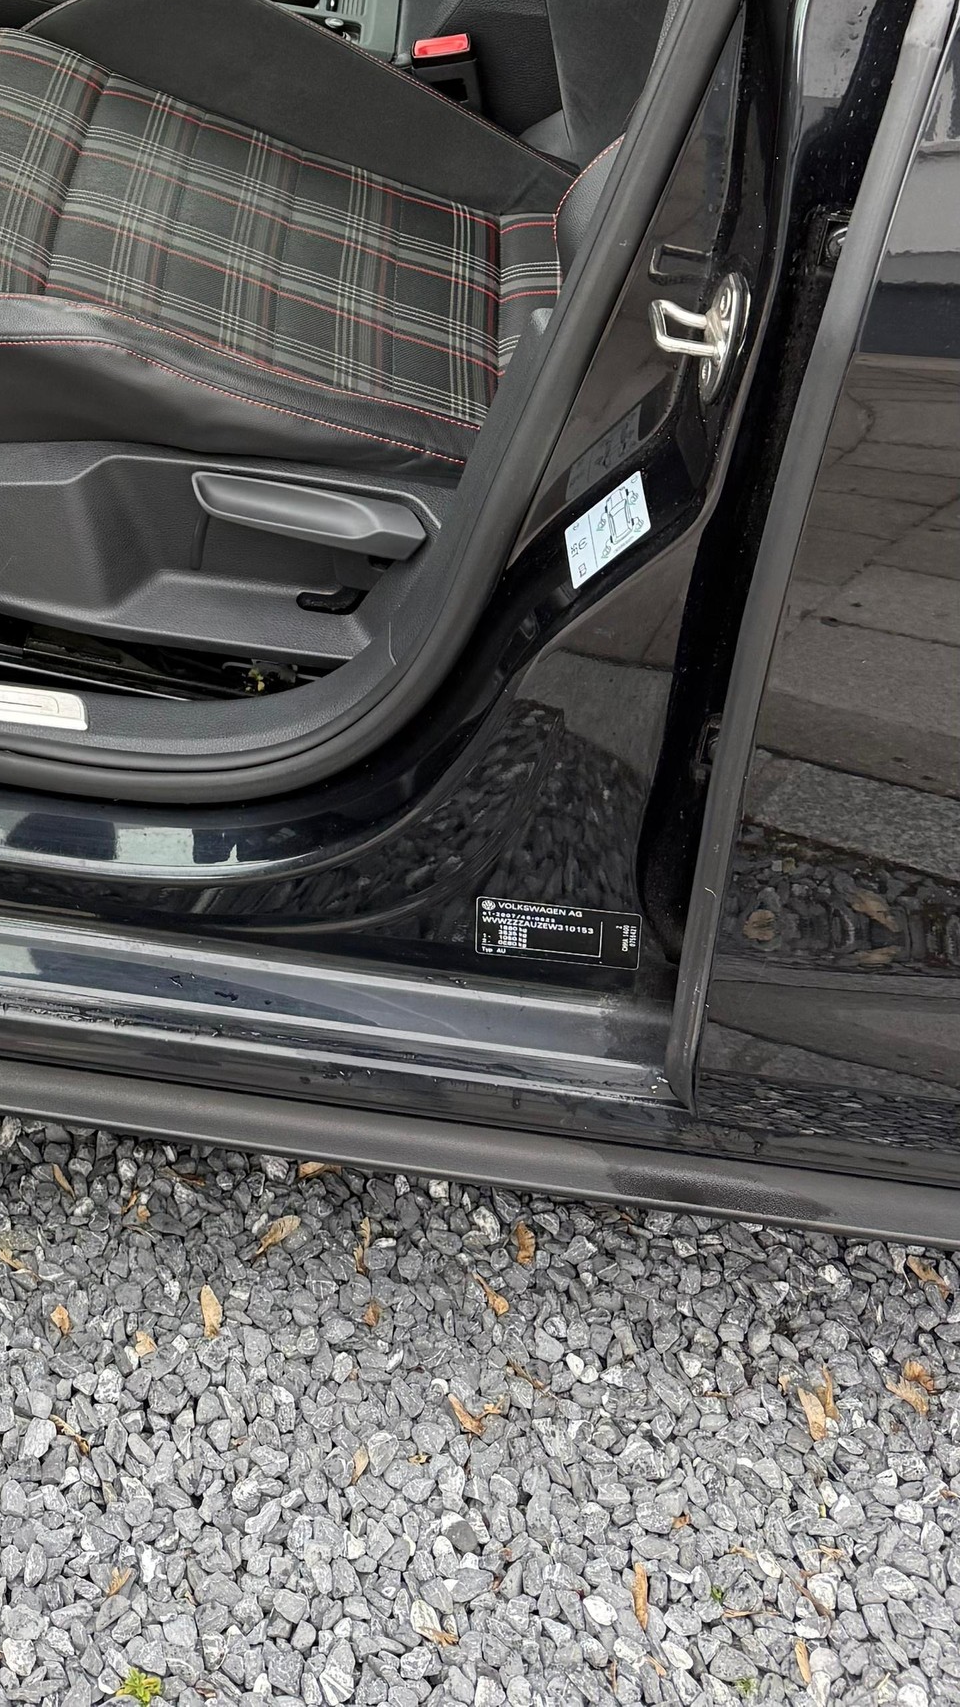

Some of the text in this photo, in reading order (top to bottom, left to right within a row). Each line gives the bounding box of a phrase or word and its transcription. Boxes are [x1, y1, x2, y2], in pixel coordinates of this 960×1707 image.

[498, 901, 567, 916] VOLKSWAGEN
[568, 909, 583, 918] AG
[482, 915, 594, 935] WVWZZZAUZEW310153
